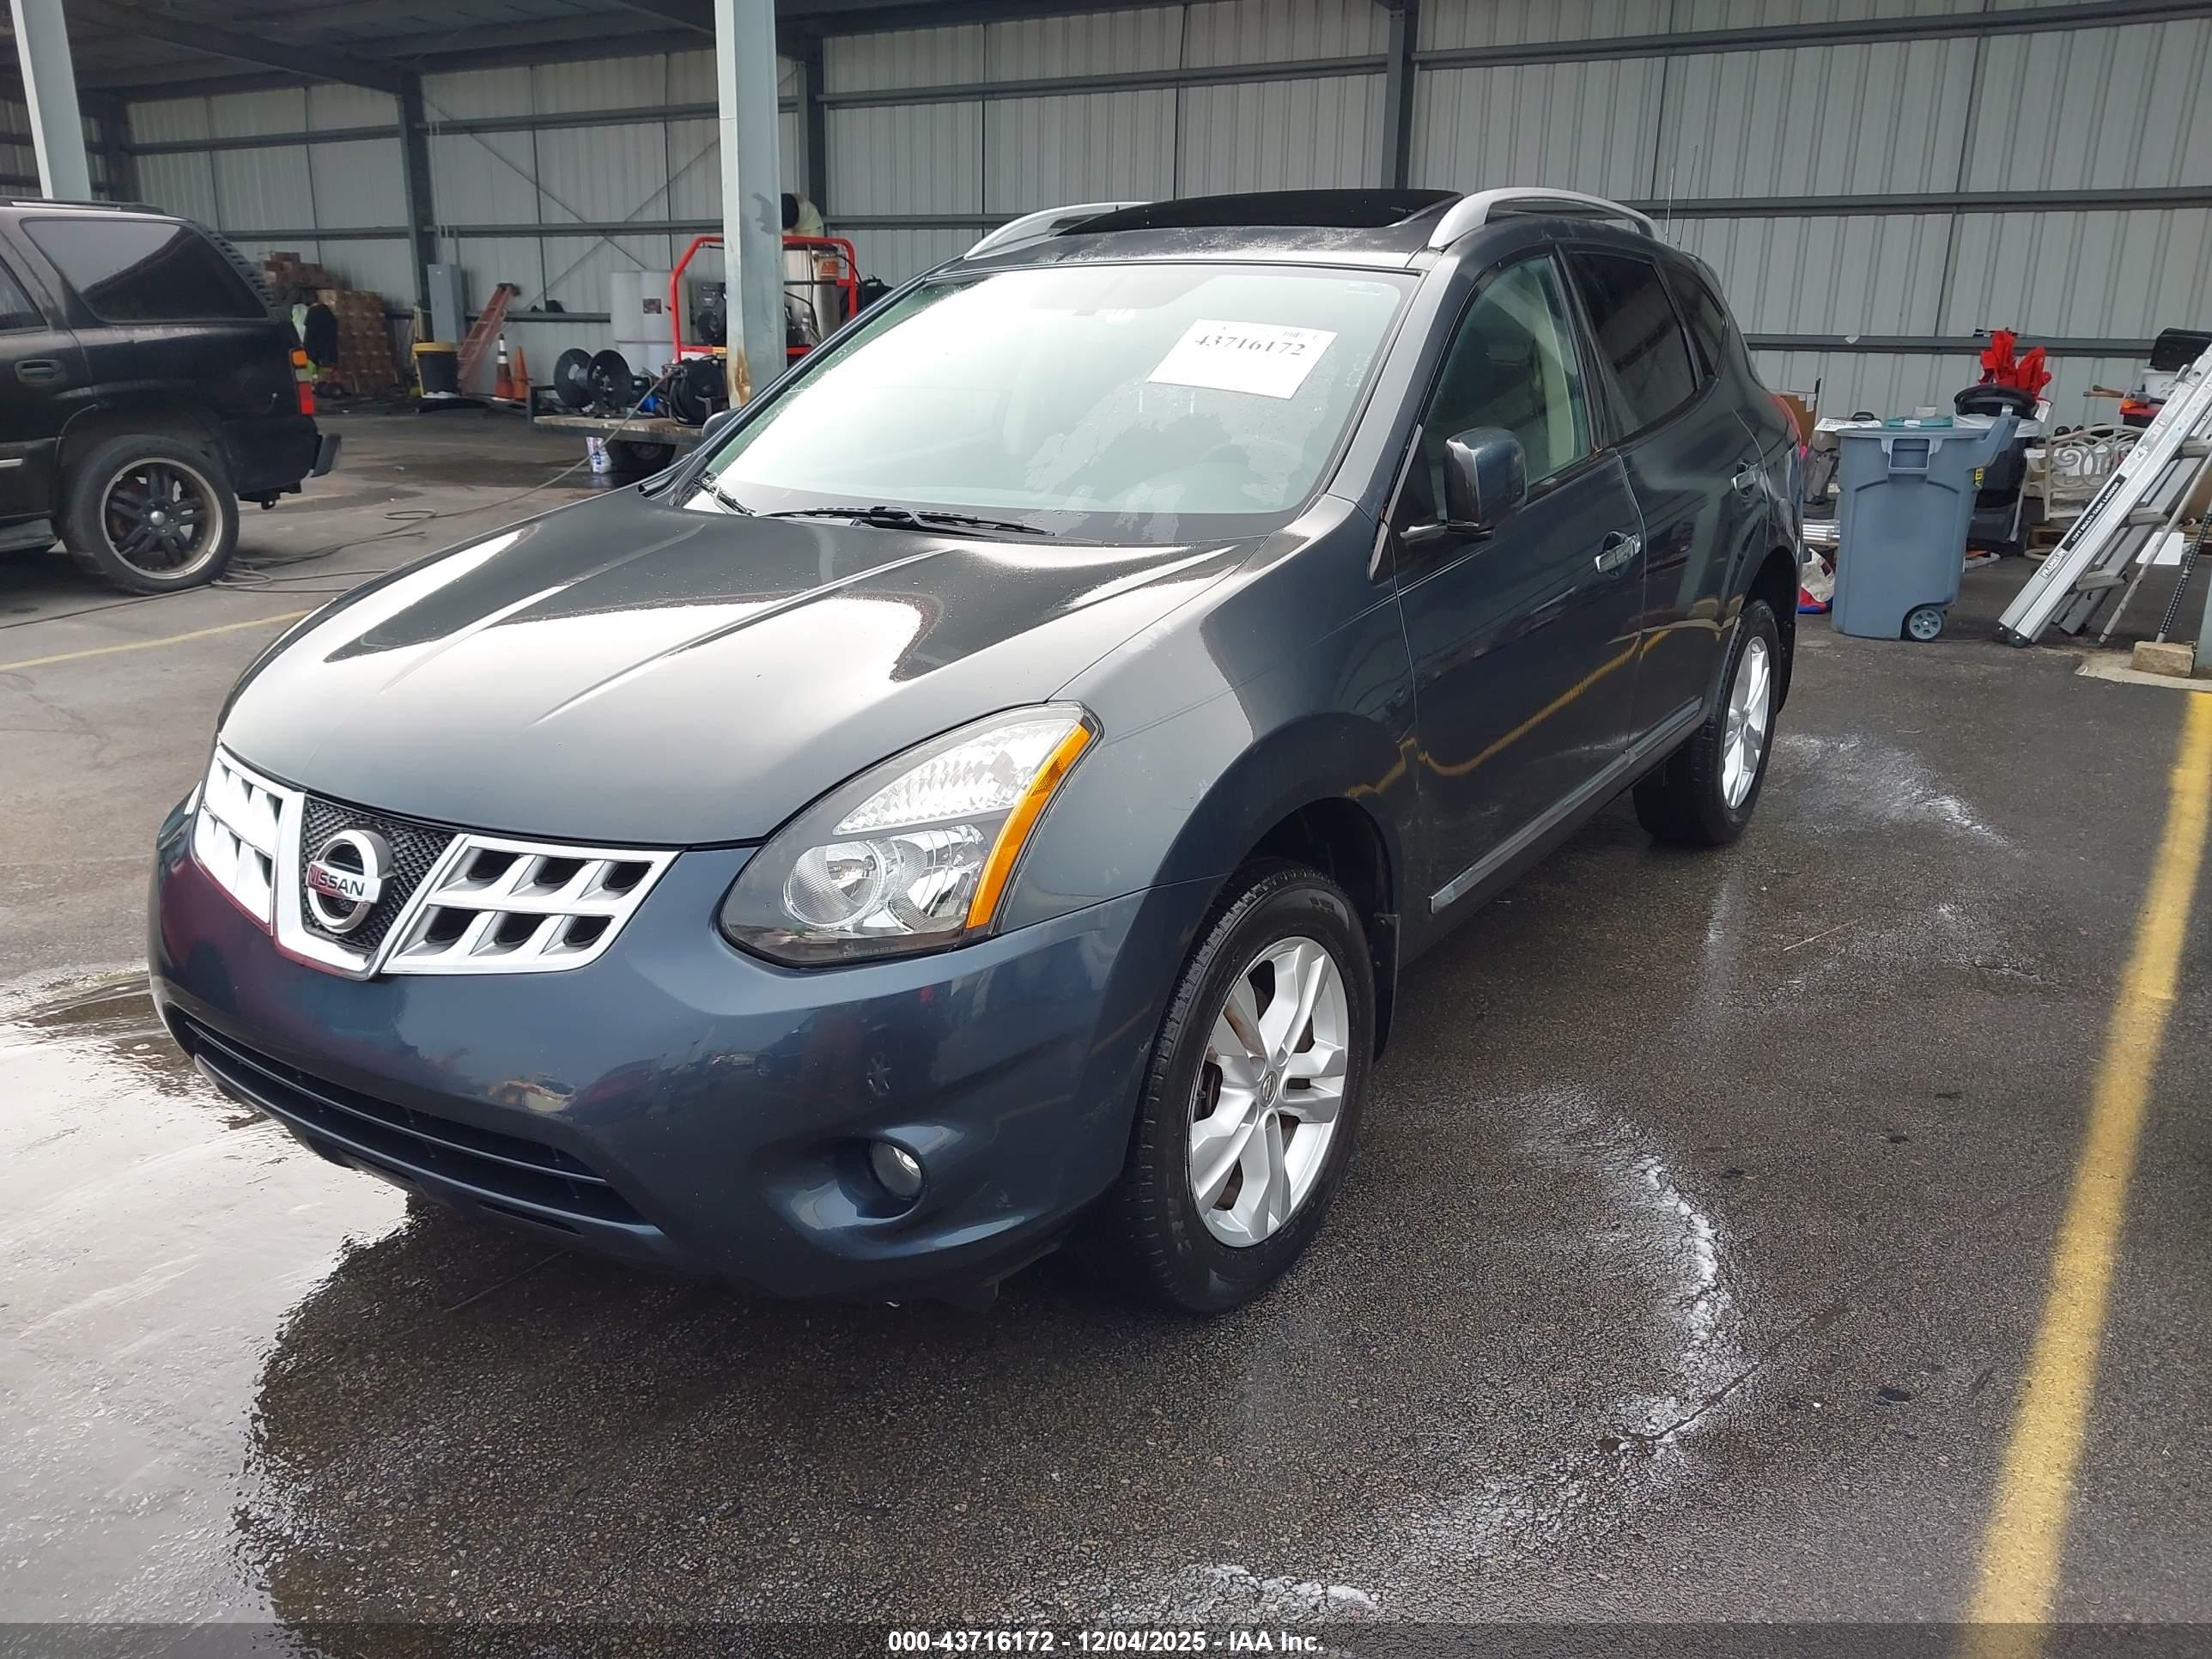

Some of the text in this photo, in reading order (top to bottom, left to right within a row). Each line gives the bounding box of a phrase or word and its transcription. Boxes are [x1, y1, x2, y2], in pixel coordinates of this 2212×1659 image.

[2080, 501, 2105, 532] MULTI-TASK
[2102, 482, 2121, 504] LADDER
[2041, 548, 2068, 579] FRANKLIN
[309, 864, 365, 896] NISSAN
